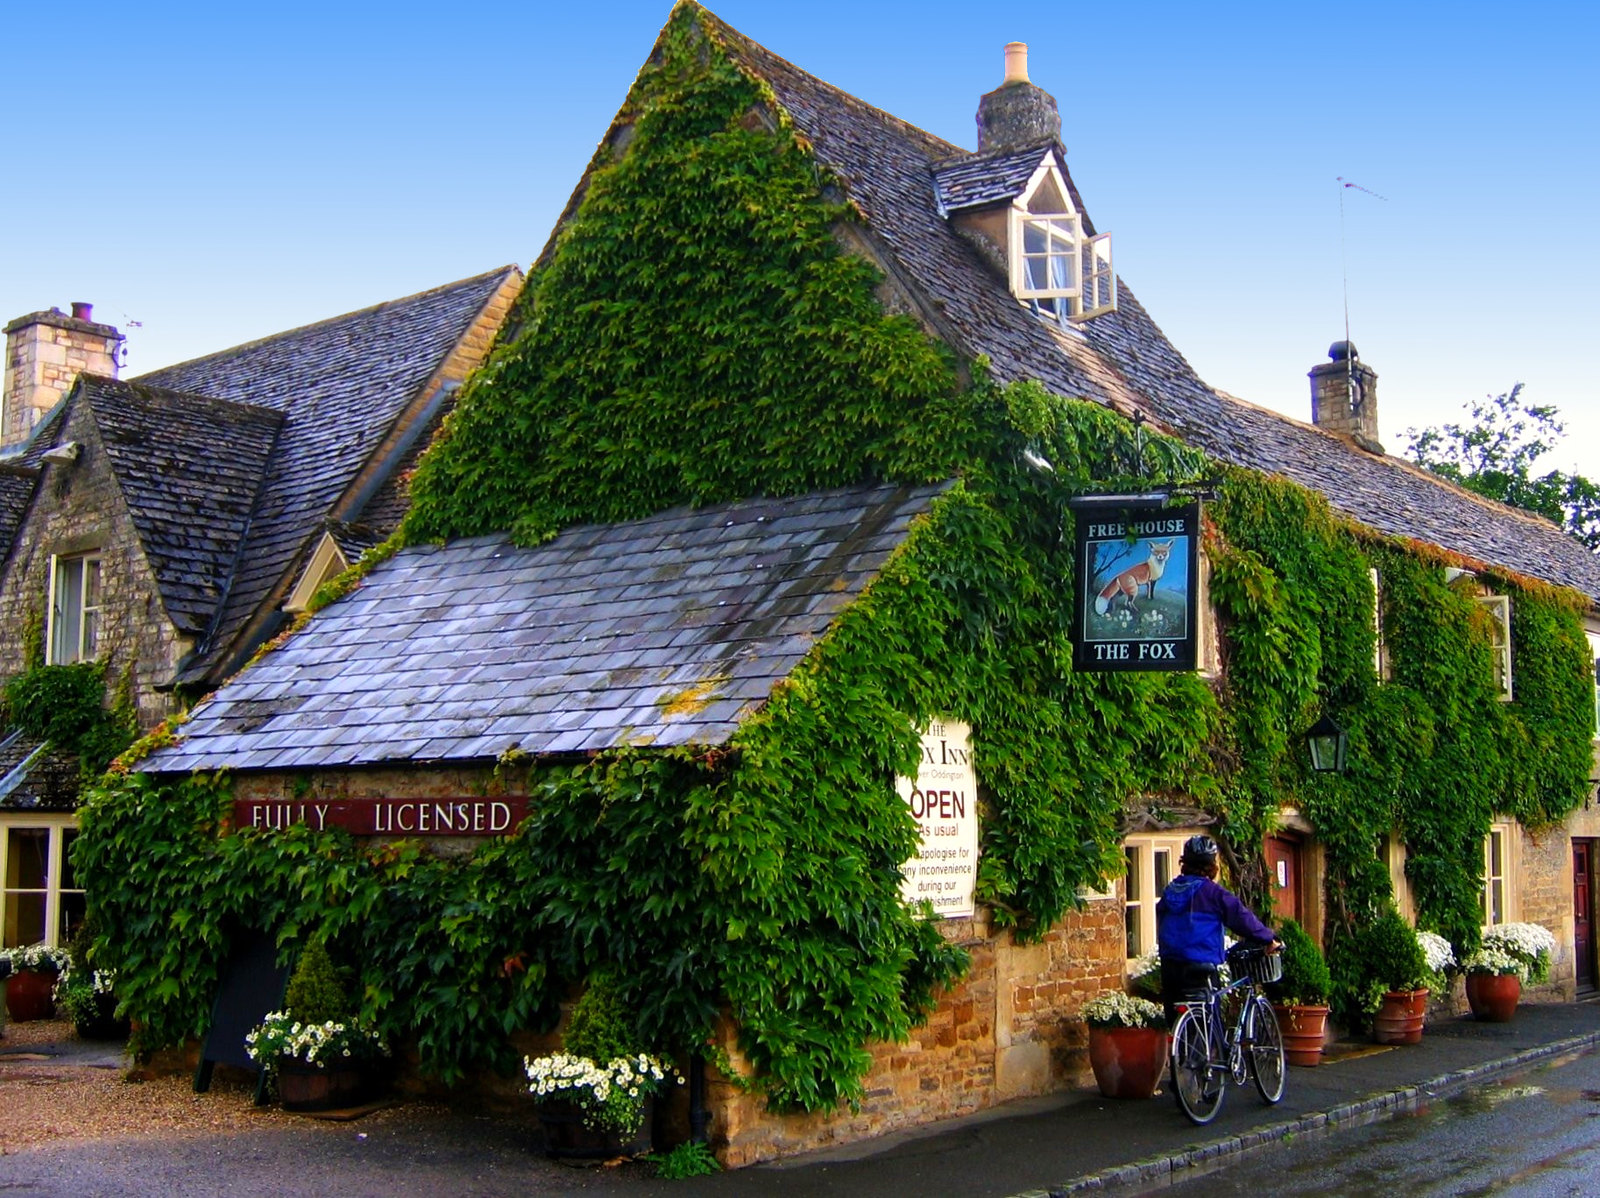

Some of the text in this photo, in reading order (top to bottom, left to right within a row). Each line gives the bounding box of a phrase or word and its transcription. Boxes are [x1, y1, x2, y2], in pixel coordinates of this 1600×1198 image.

[1088, 519, 1185, 537] FREE HOUSE
[1094, 643, 1176, 660] THE FOX
[910, 789, 965, 819] OPEN
[375, 802, 511, 831] LICENSED
[919, 822, 959, 837] As usual
[920, 846, 970, 862] apologise for
[902, 863, 972, 879] any inconvenience
[917, 880, 957, 893] during our
